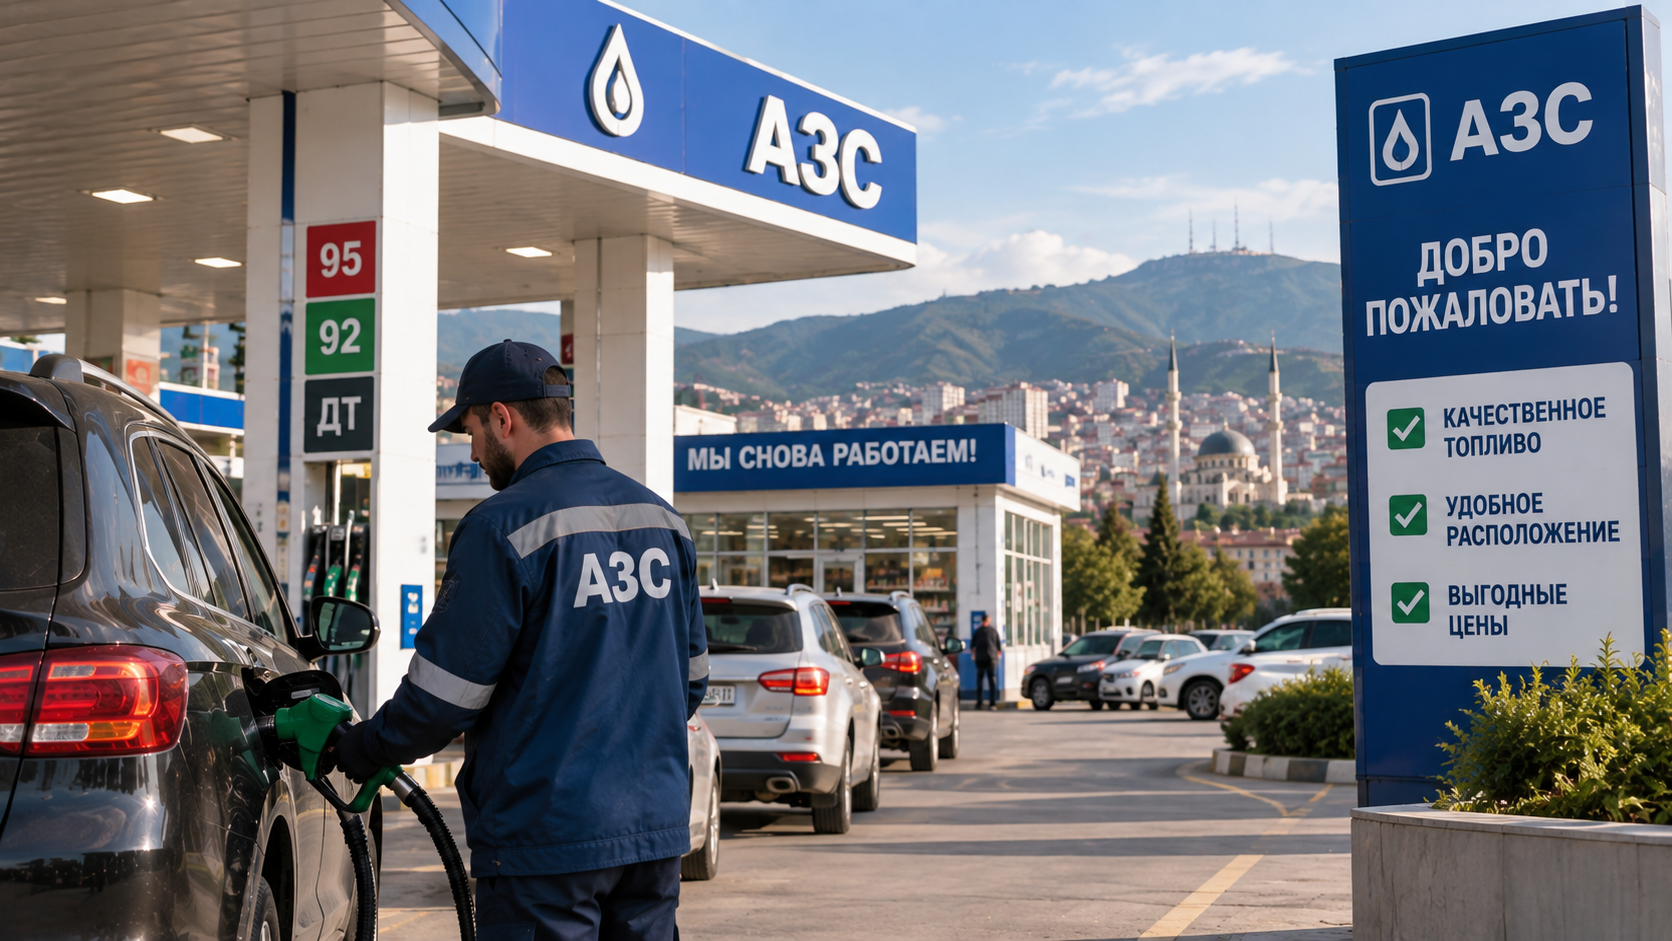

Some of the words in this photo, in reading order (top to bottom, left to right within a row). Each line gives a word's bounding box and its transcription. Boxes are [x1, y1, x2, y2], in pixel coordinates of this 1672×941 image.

[1450, 82, 1593, 161] АЗС
[747, 95, 882, 209] АЗС
[320, 240, 362, 278] 95
[1417, 228, 1548, 287] ДОБРО
[1366, 275, 1618, 336] ПОЖАЛОВАТЬ!
[319, 318, 361, 355] 92
[317, 396, 361, 437] ДТ
[1443, 397, 1606, 428] КАЧЕСТВЕННОЕ
[688, 447, 731, 471] МЫ
[738, 444, 825, 469] СНОВА
[832, 439, 977, 466] РАБОТАЕМ!
[1444, 431, 1541, 457] ТОПЛИВО
[1446, 492, 1543, 519] УДОБНОЕ
[1447, 520, 1620, 546] РАСПОЛОЖЕНИЕ
[573, 547, 672, 608] АЗС
[1448, 583, 1567, 608] ВЫГОДНЫЕ
[1449, 615, 1508, 639] ЦЕНЫ
